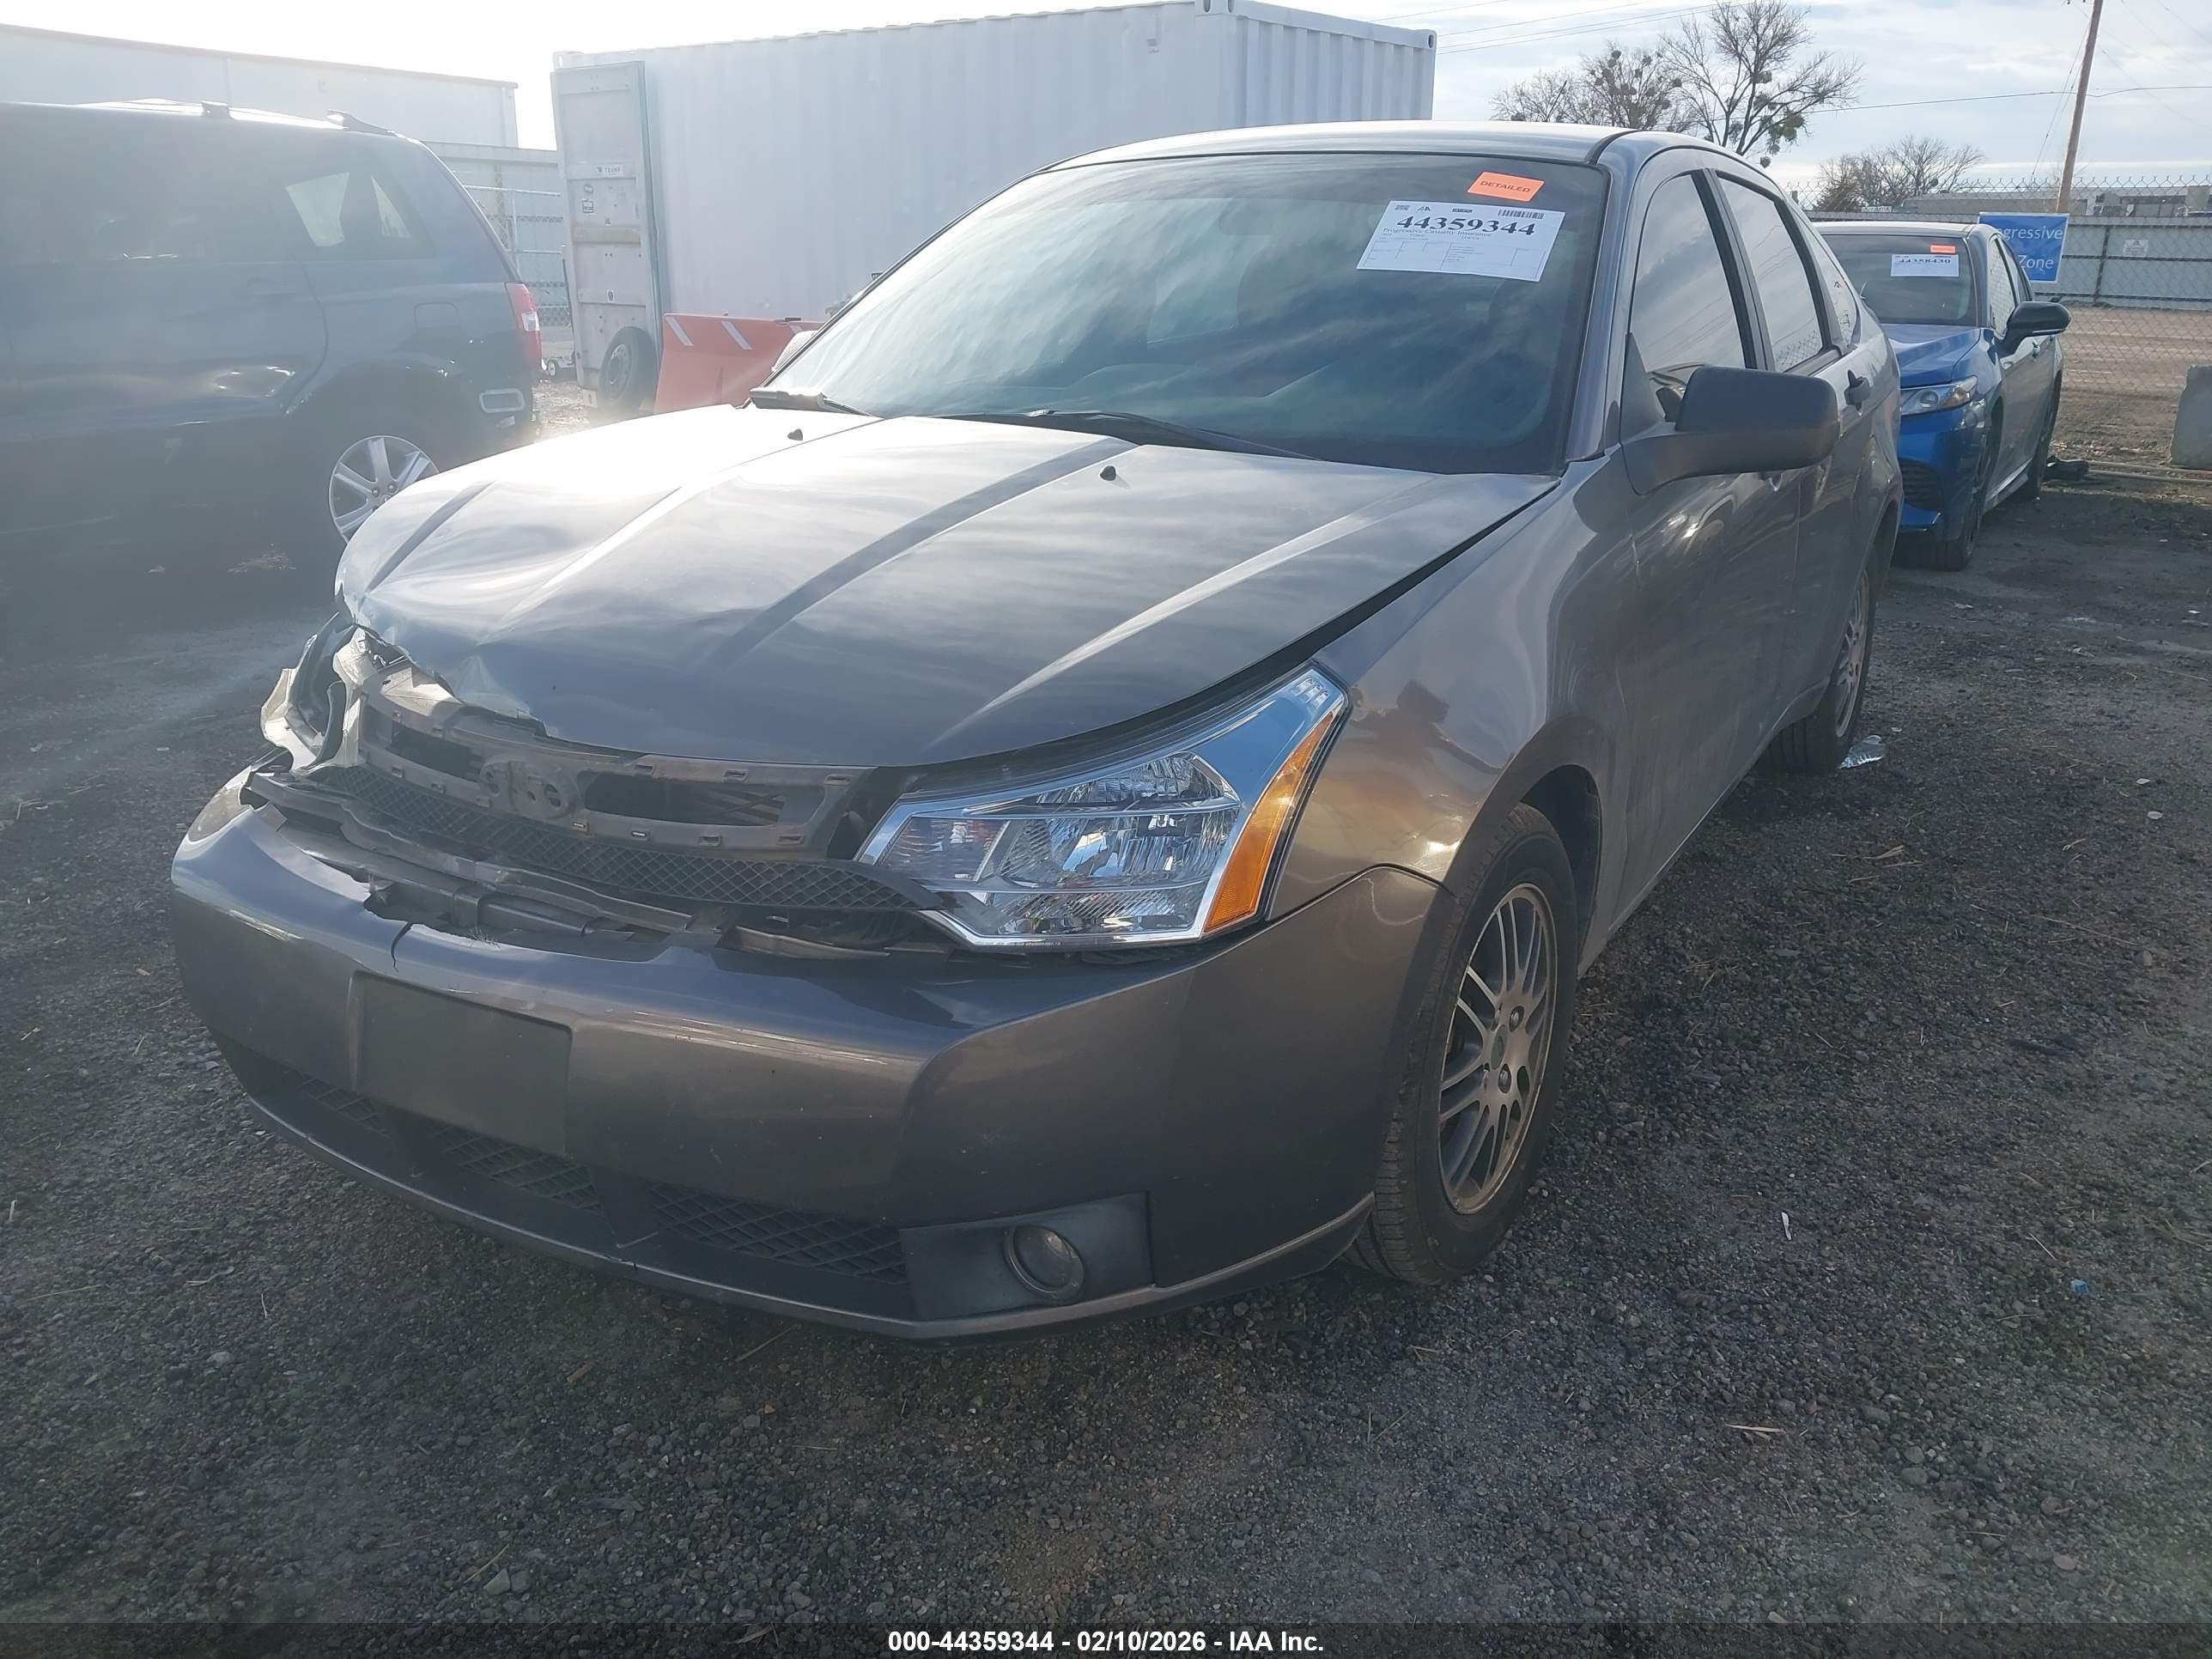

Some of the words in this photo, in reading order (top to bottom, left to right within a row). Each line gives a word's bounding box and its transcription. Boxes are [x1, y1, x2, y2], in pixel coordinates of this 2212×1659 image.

[1480, 180, 1531, 192] DETAILED
[1397, 216, 1534, 235] 44359344
[2018, 254, 2054, 270] Zone
